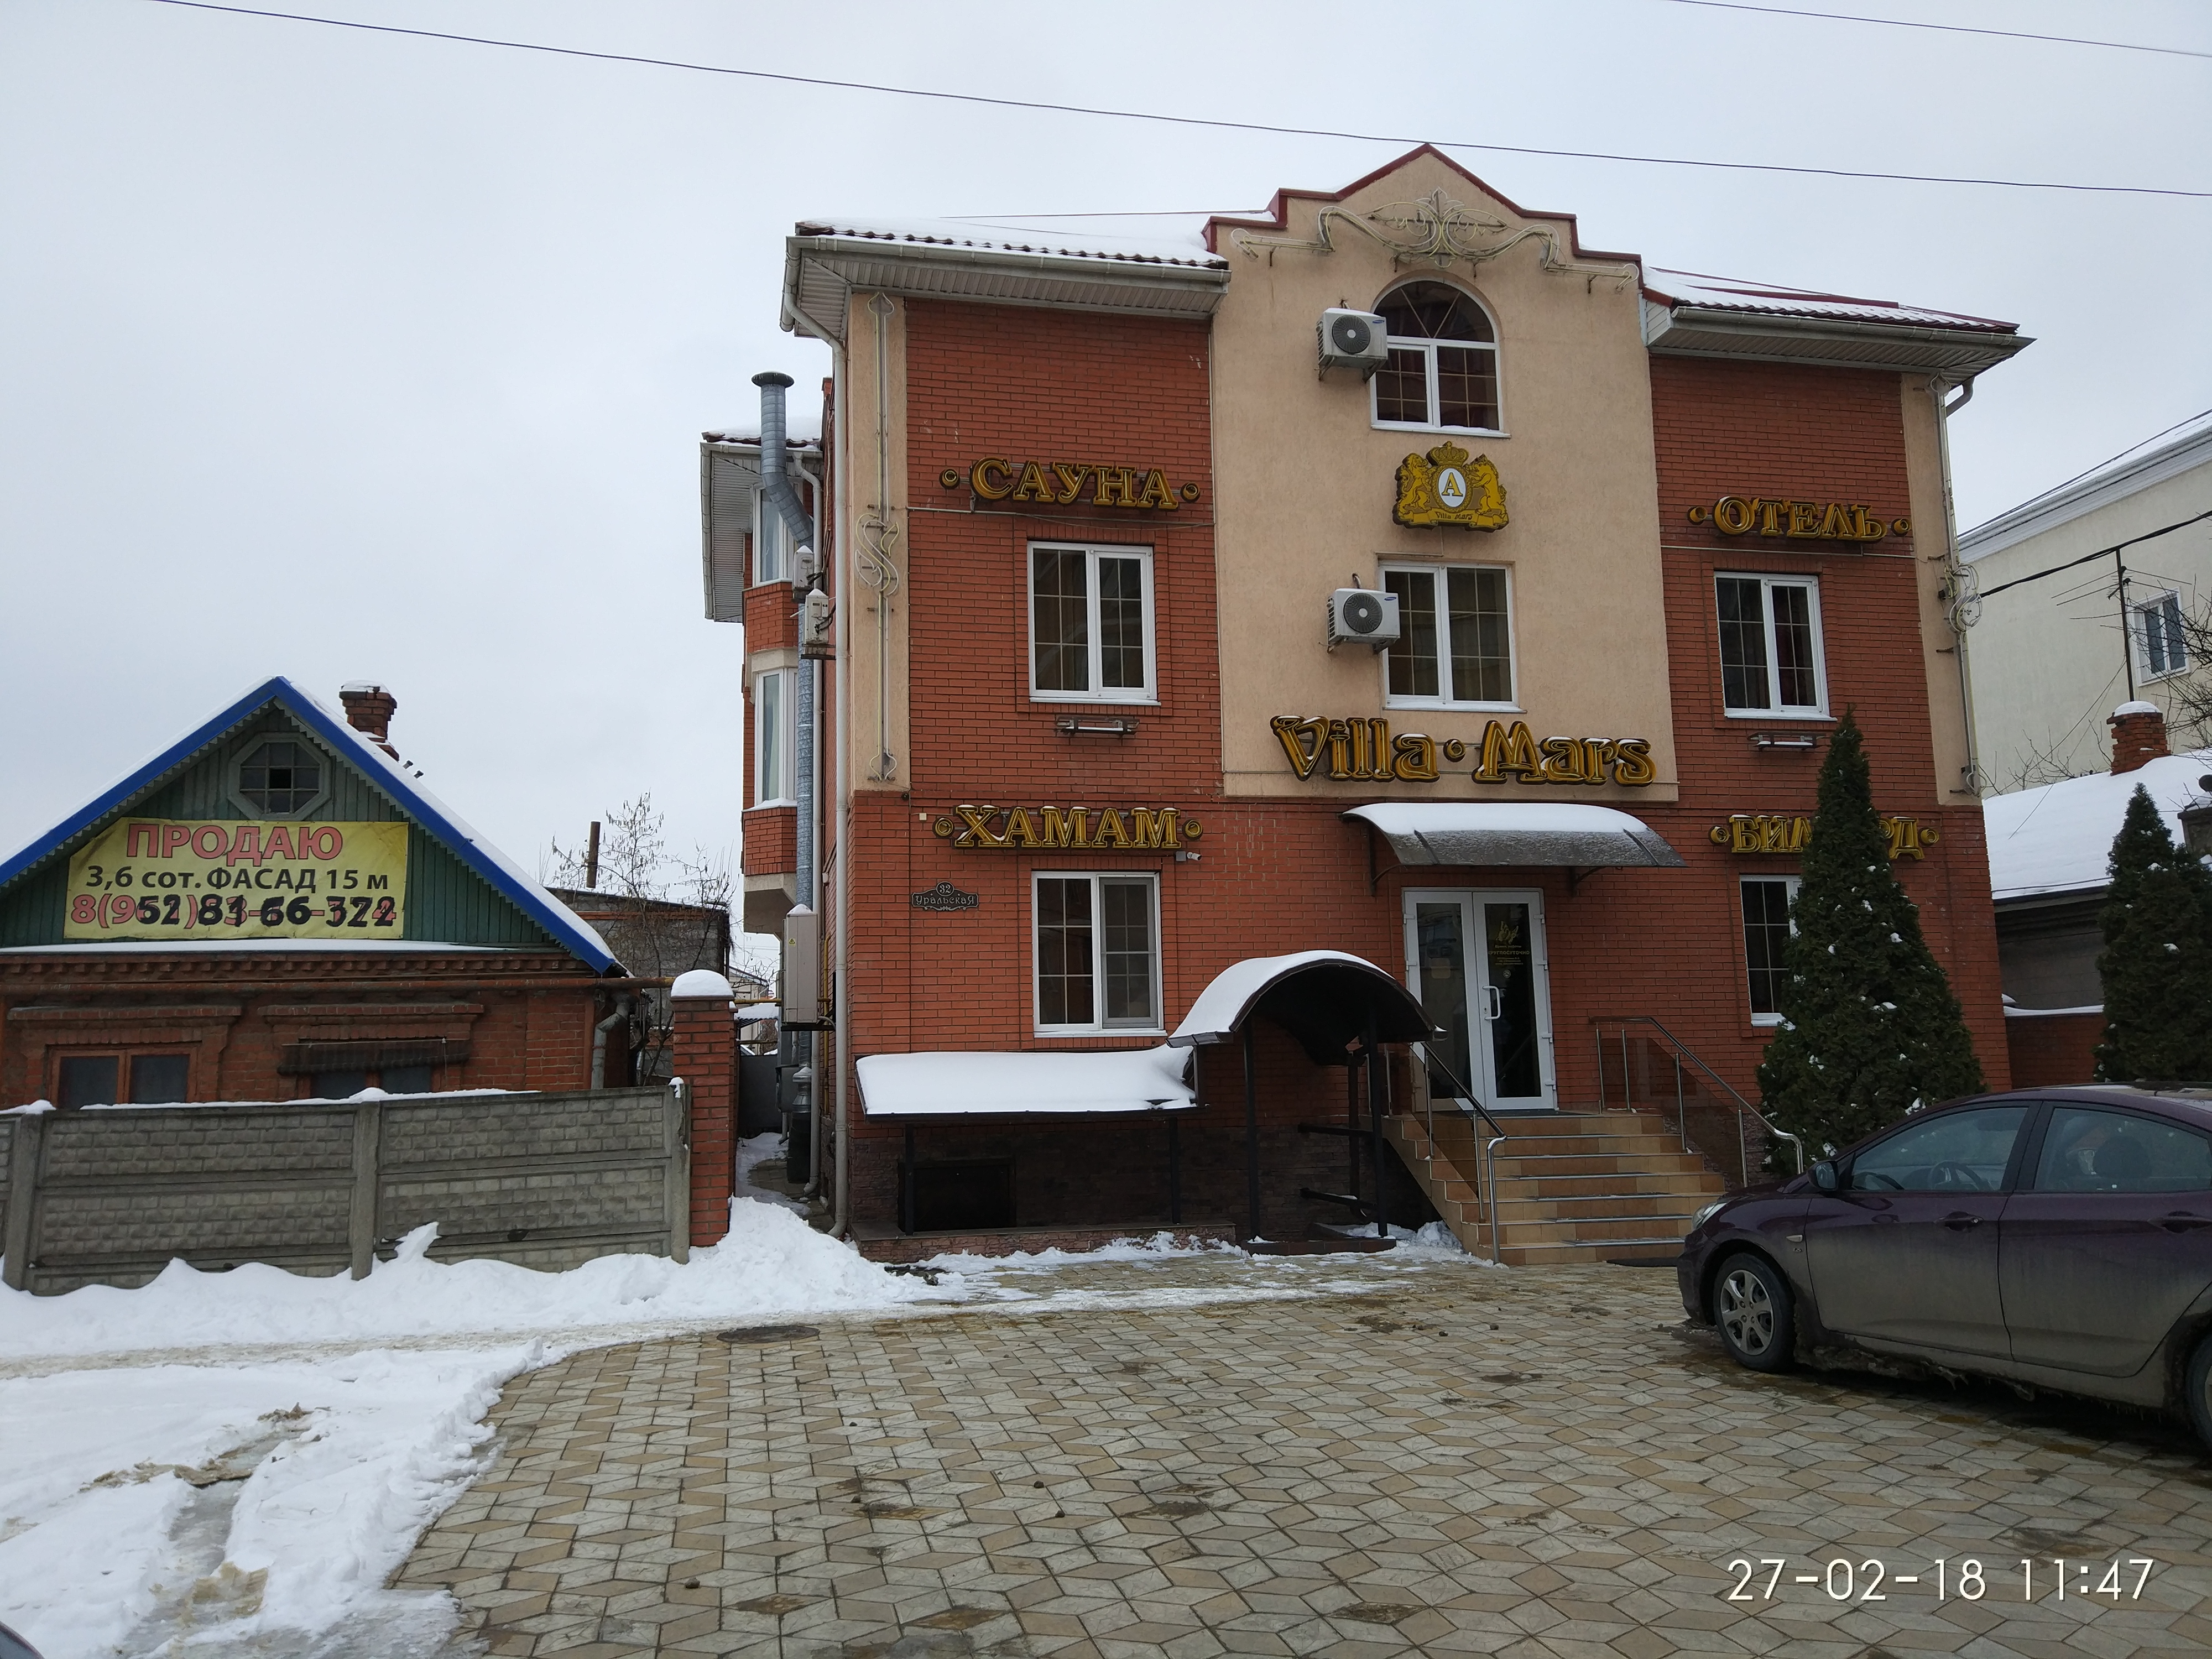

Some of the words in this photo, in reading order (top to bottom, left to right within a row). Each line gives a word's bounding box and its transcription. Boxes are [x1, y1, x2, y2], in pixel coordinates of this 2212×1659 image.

[970, 457, 1178, 510] САУНА
[1713, 496, 1887, 541] ОТЕЛЬ
[1270, 714, 1440, 784] Villa
[1472, 719, 1657, 786] Mars
[127, 822, 343, 867] ПРОДАЮ
[952, 805, 1182, 849] ХАМАМ
[1728, 815, 1926, 860] БИЛРД
[86, 865, 133, 891] 3,6
[207, 868, 316, 894] ФАСАД
[326, 870, 359, 890] 15
[940, 884, 951, 894] 32
